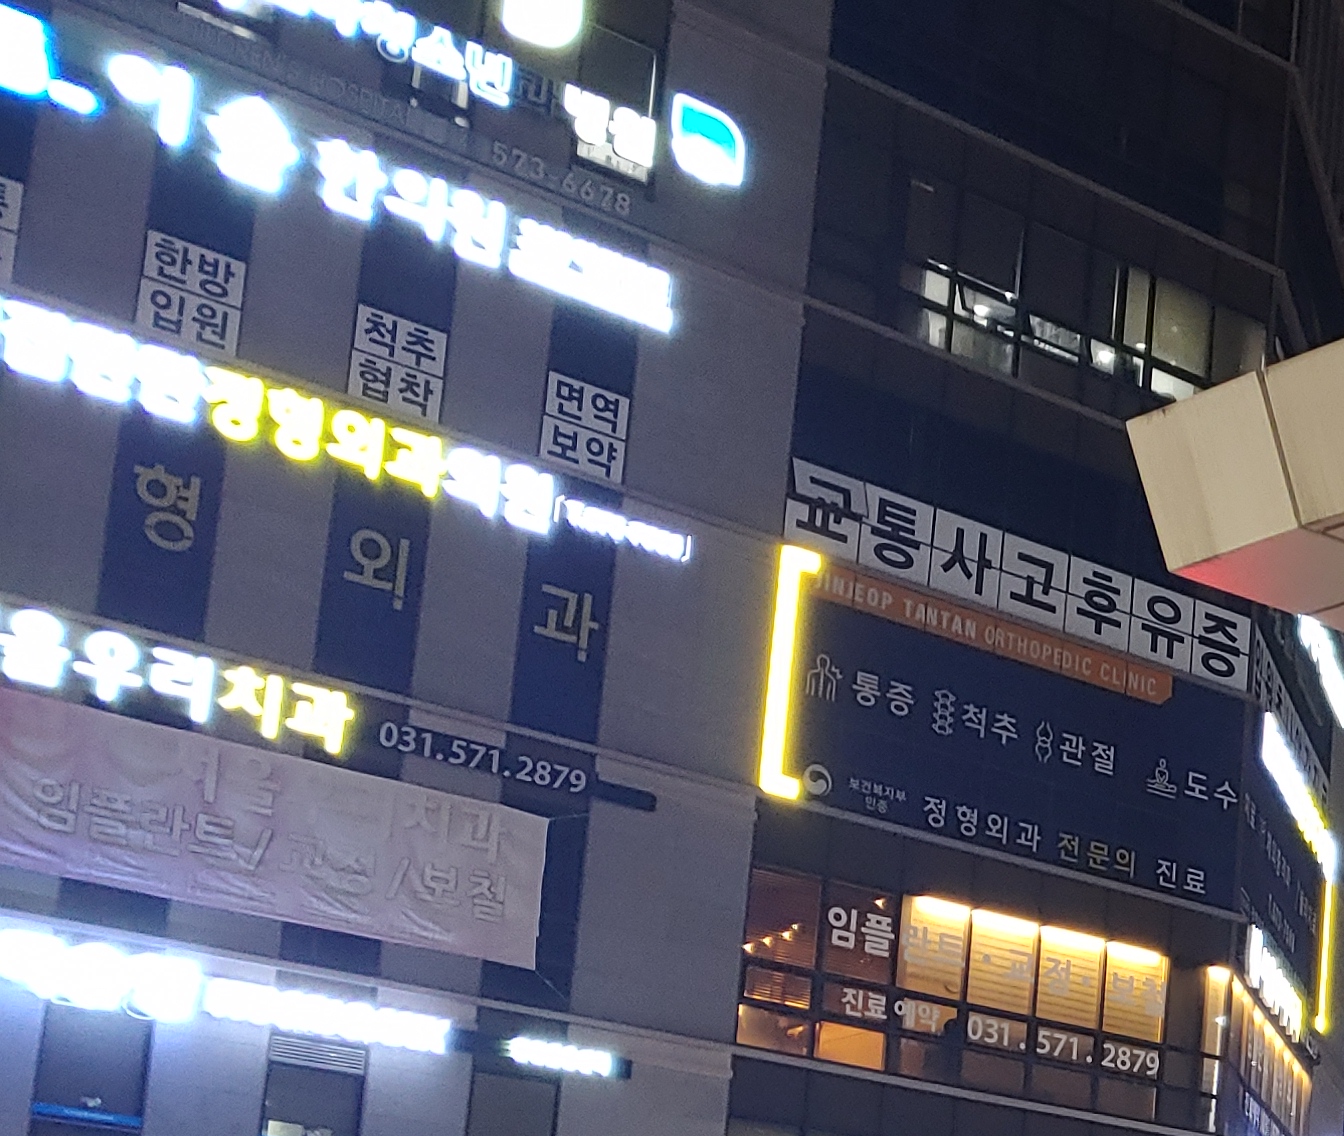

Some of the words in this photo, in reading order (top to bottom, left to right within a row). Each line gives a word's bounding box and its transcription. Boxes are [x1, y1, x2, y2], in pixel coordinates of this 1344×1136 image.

[490, 138, 632, 216] 573-6678
[153, 237, 237, 299] 한방
[149, 290, 230, 350] 입원
[361, 310, 441, 368] 척추
[355, 363, 436, 417] 협착
[552, 377, 621, 432] 면역
[546, 425, 619, 479] 보약
[134, 463, 201, 552] 형
[343, 527, 410, 610] 외
[533, 583, 600, 661] 과
[795, 473, 1244, 679] 교통사고후유증
[903, 599, 977, 642] TANTAN
[984, 625, 1093, 678] ORTHOPEDIC
[1100, 662, 1158, 697] CLINIC
[851, 670, 916, 717] 통증
[961, 703, 1020, 745] 척추
[378, 721, 587, 794] 031.571.2879
[1059, 732, 1117, 776] 관절
[847, 776, 908, 804] 보건복지부
[864, 796, 889, 816] 인증
[1183, 768, 1240, 812] 도수
[922, 795, 1042, 852] 정형외과
[1056, 831, 1137, 878] 전문의
[1154, 857, 1207, 895] 진료
[827, 906, 966, 970] 임플란트
[998, 949, 1073, 998] 교정
[1110, 970, 1167, 1019] 보철
[840, 986, 888, 1020] 진료
[893, 999, 941, 1034] 예약
